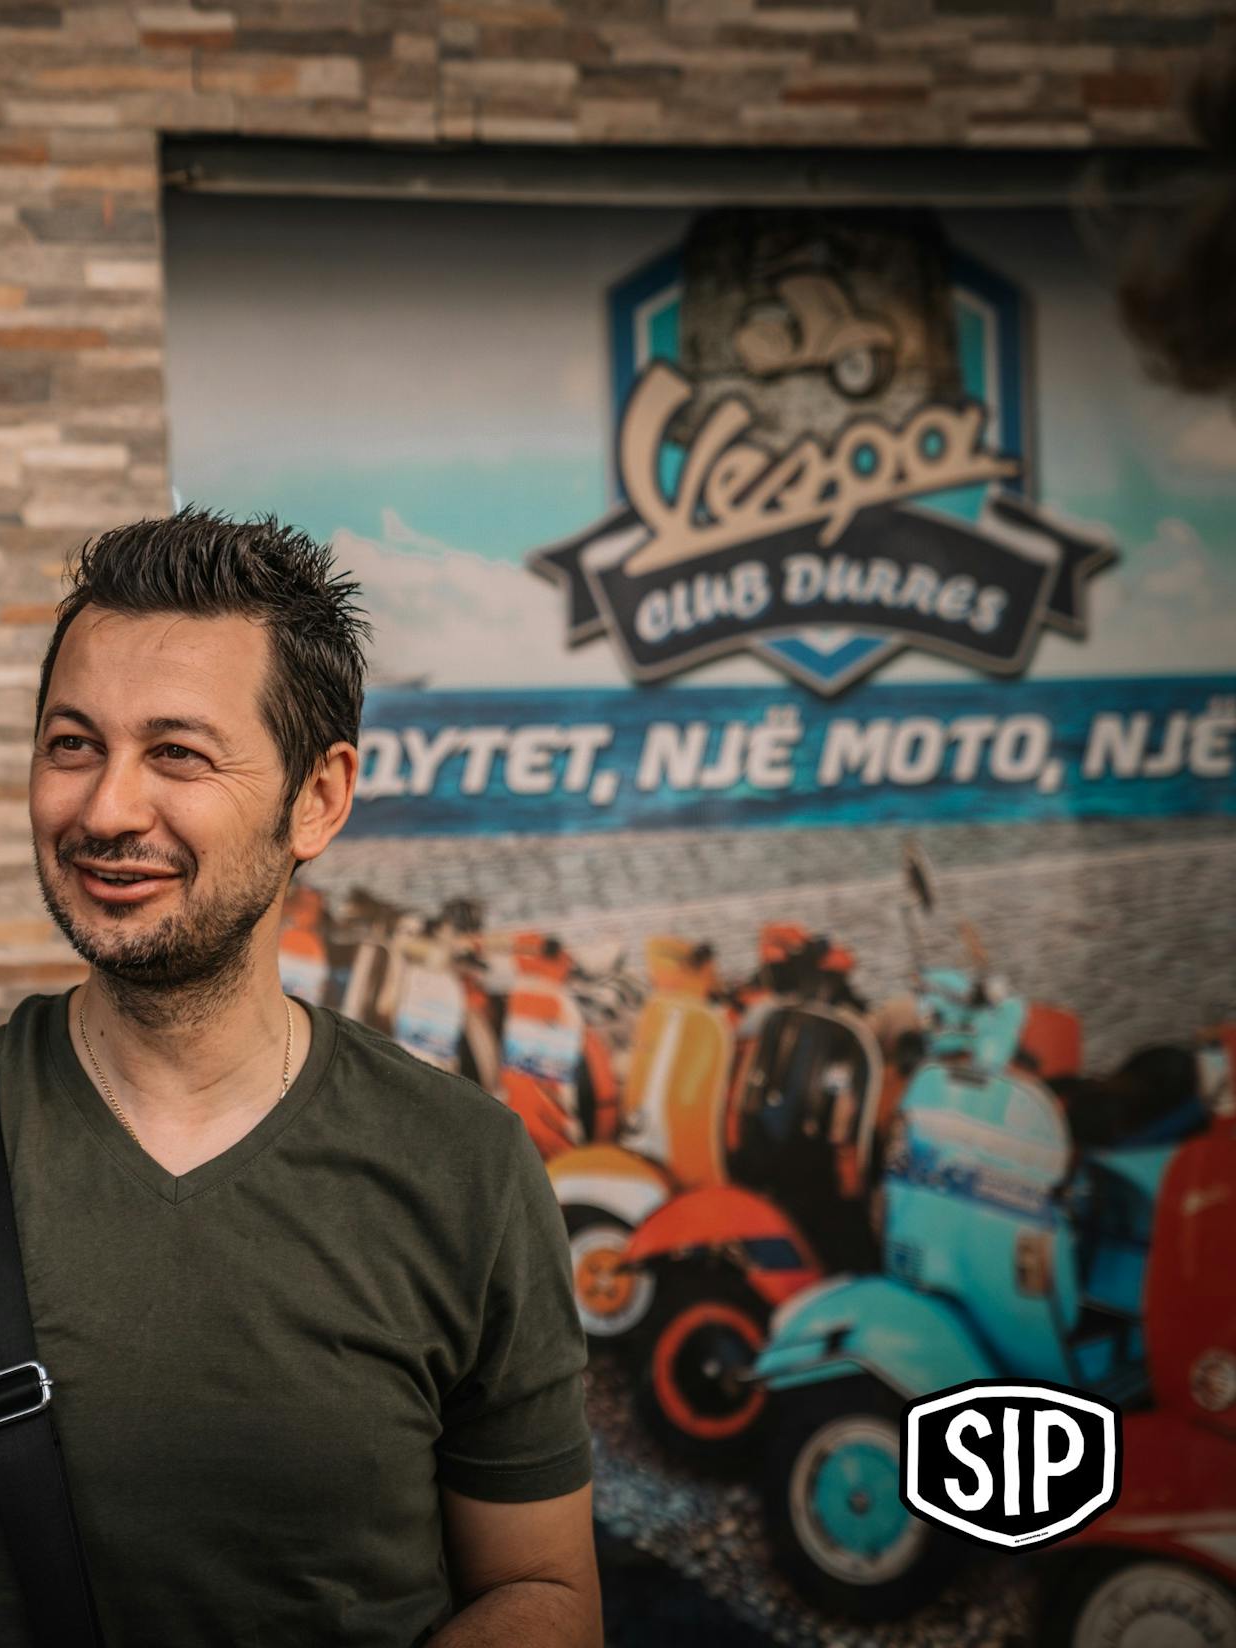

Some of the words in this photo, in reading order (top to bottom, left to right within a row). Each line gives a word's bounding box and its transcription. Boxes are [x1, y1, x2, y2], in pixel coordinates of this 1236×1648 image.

[620, 360, 1020, 577] Vespa
[636, 703, 804, 791] NJË
[817, 714, 1063, 795] MOTO,
[1082, 694, 1236, 780] NJË
